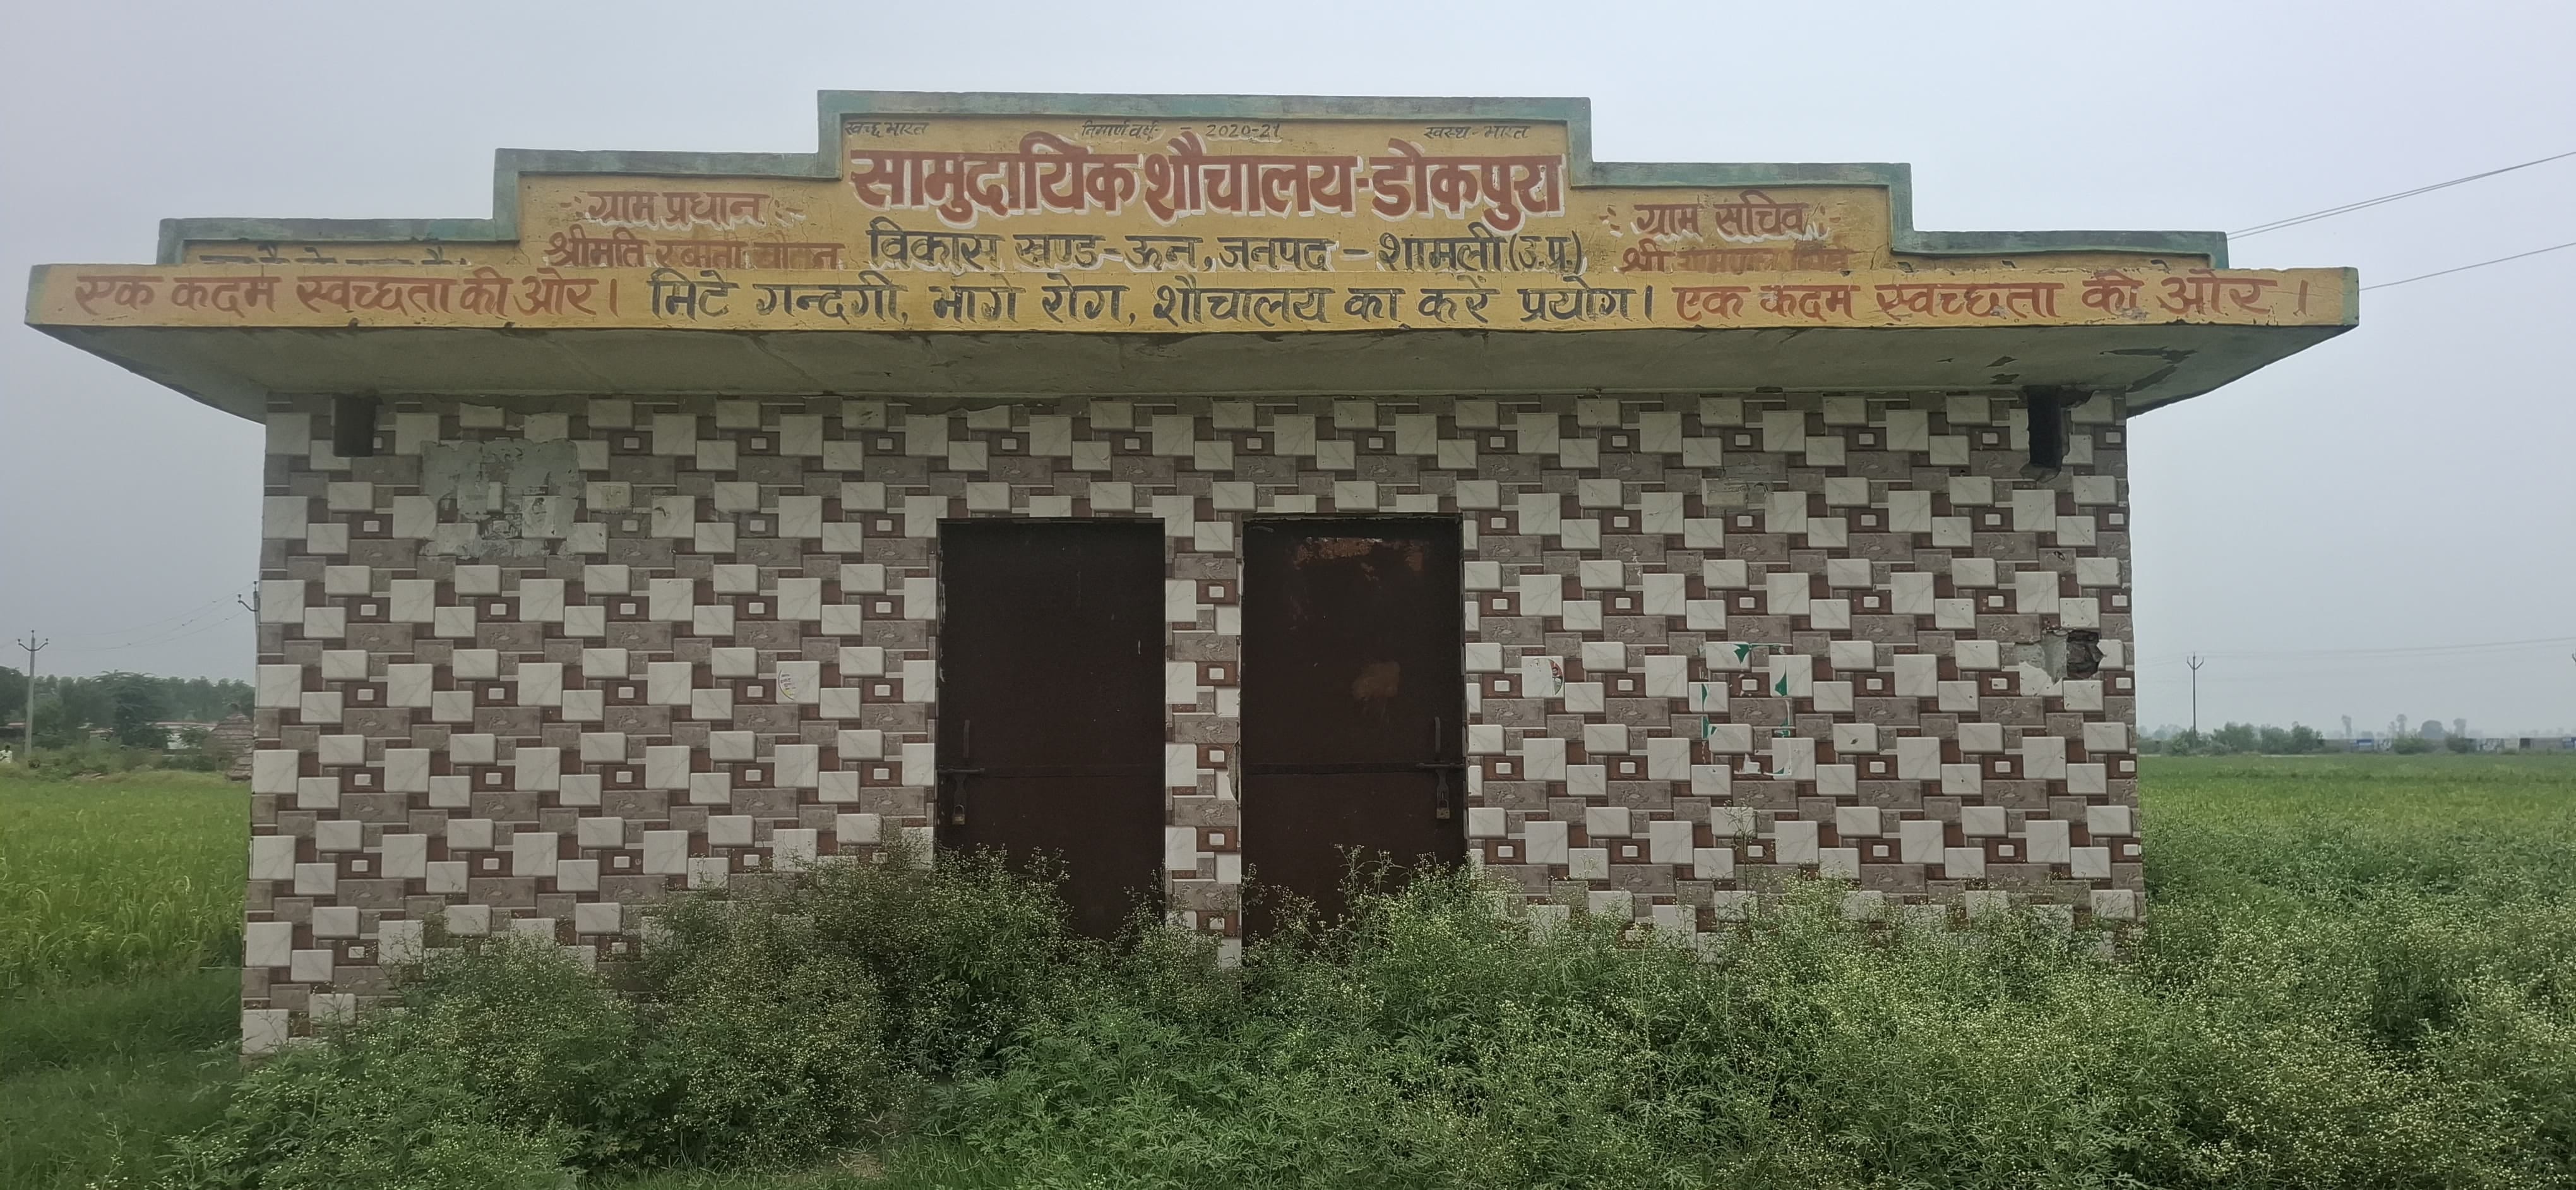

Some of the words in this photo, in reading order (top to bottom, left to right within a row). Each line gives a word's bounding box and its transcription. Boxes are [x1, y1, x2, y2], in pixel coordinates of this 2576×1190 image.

[883, 121, 930, 136] भारत
[1205, 123, 1281, 138] 2020-21
[849, 131, 1142, 225] सामुदायिक
[586, 191, 659, 222] ग्राम
[662, 191, 770, 226] प्रधान
[1634, 203, 1705, 237] ग्राम
[1713, 189, 1810, 237] सचिव
[866, 217, 1006, 272] विकास
[1619, 238, 1678, 272] श्री
[171, 276, 282, 318] कदम
[295, 276, 458, 315] स्वच्छता
[459, 266, 514, 317] की
[646, 267, 741, 322] मिटे
[1152, 273, 1336, 328] शौचालय
[1344, 287, 1406, 323] का
[1417, 273, 1501, 324] करें
[1671, 285, 1752, 323] एक
[1758, 284, 1861, 323] कदम
[1874, 282, 2065, 322] स्वच्छता
